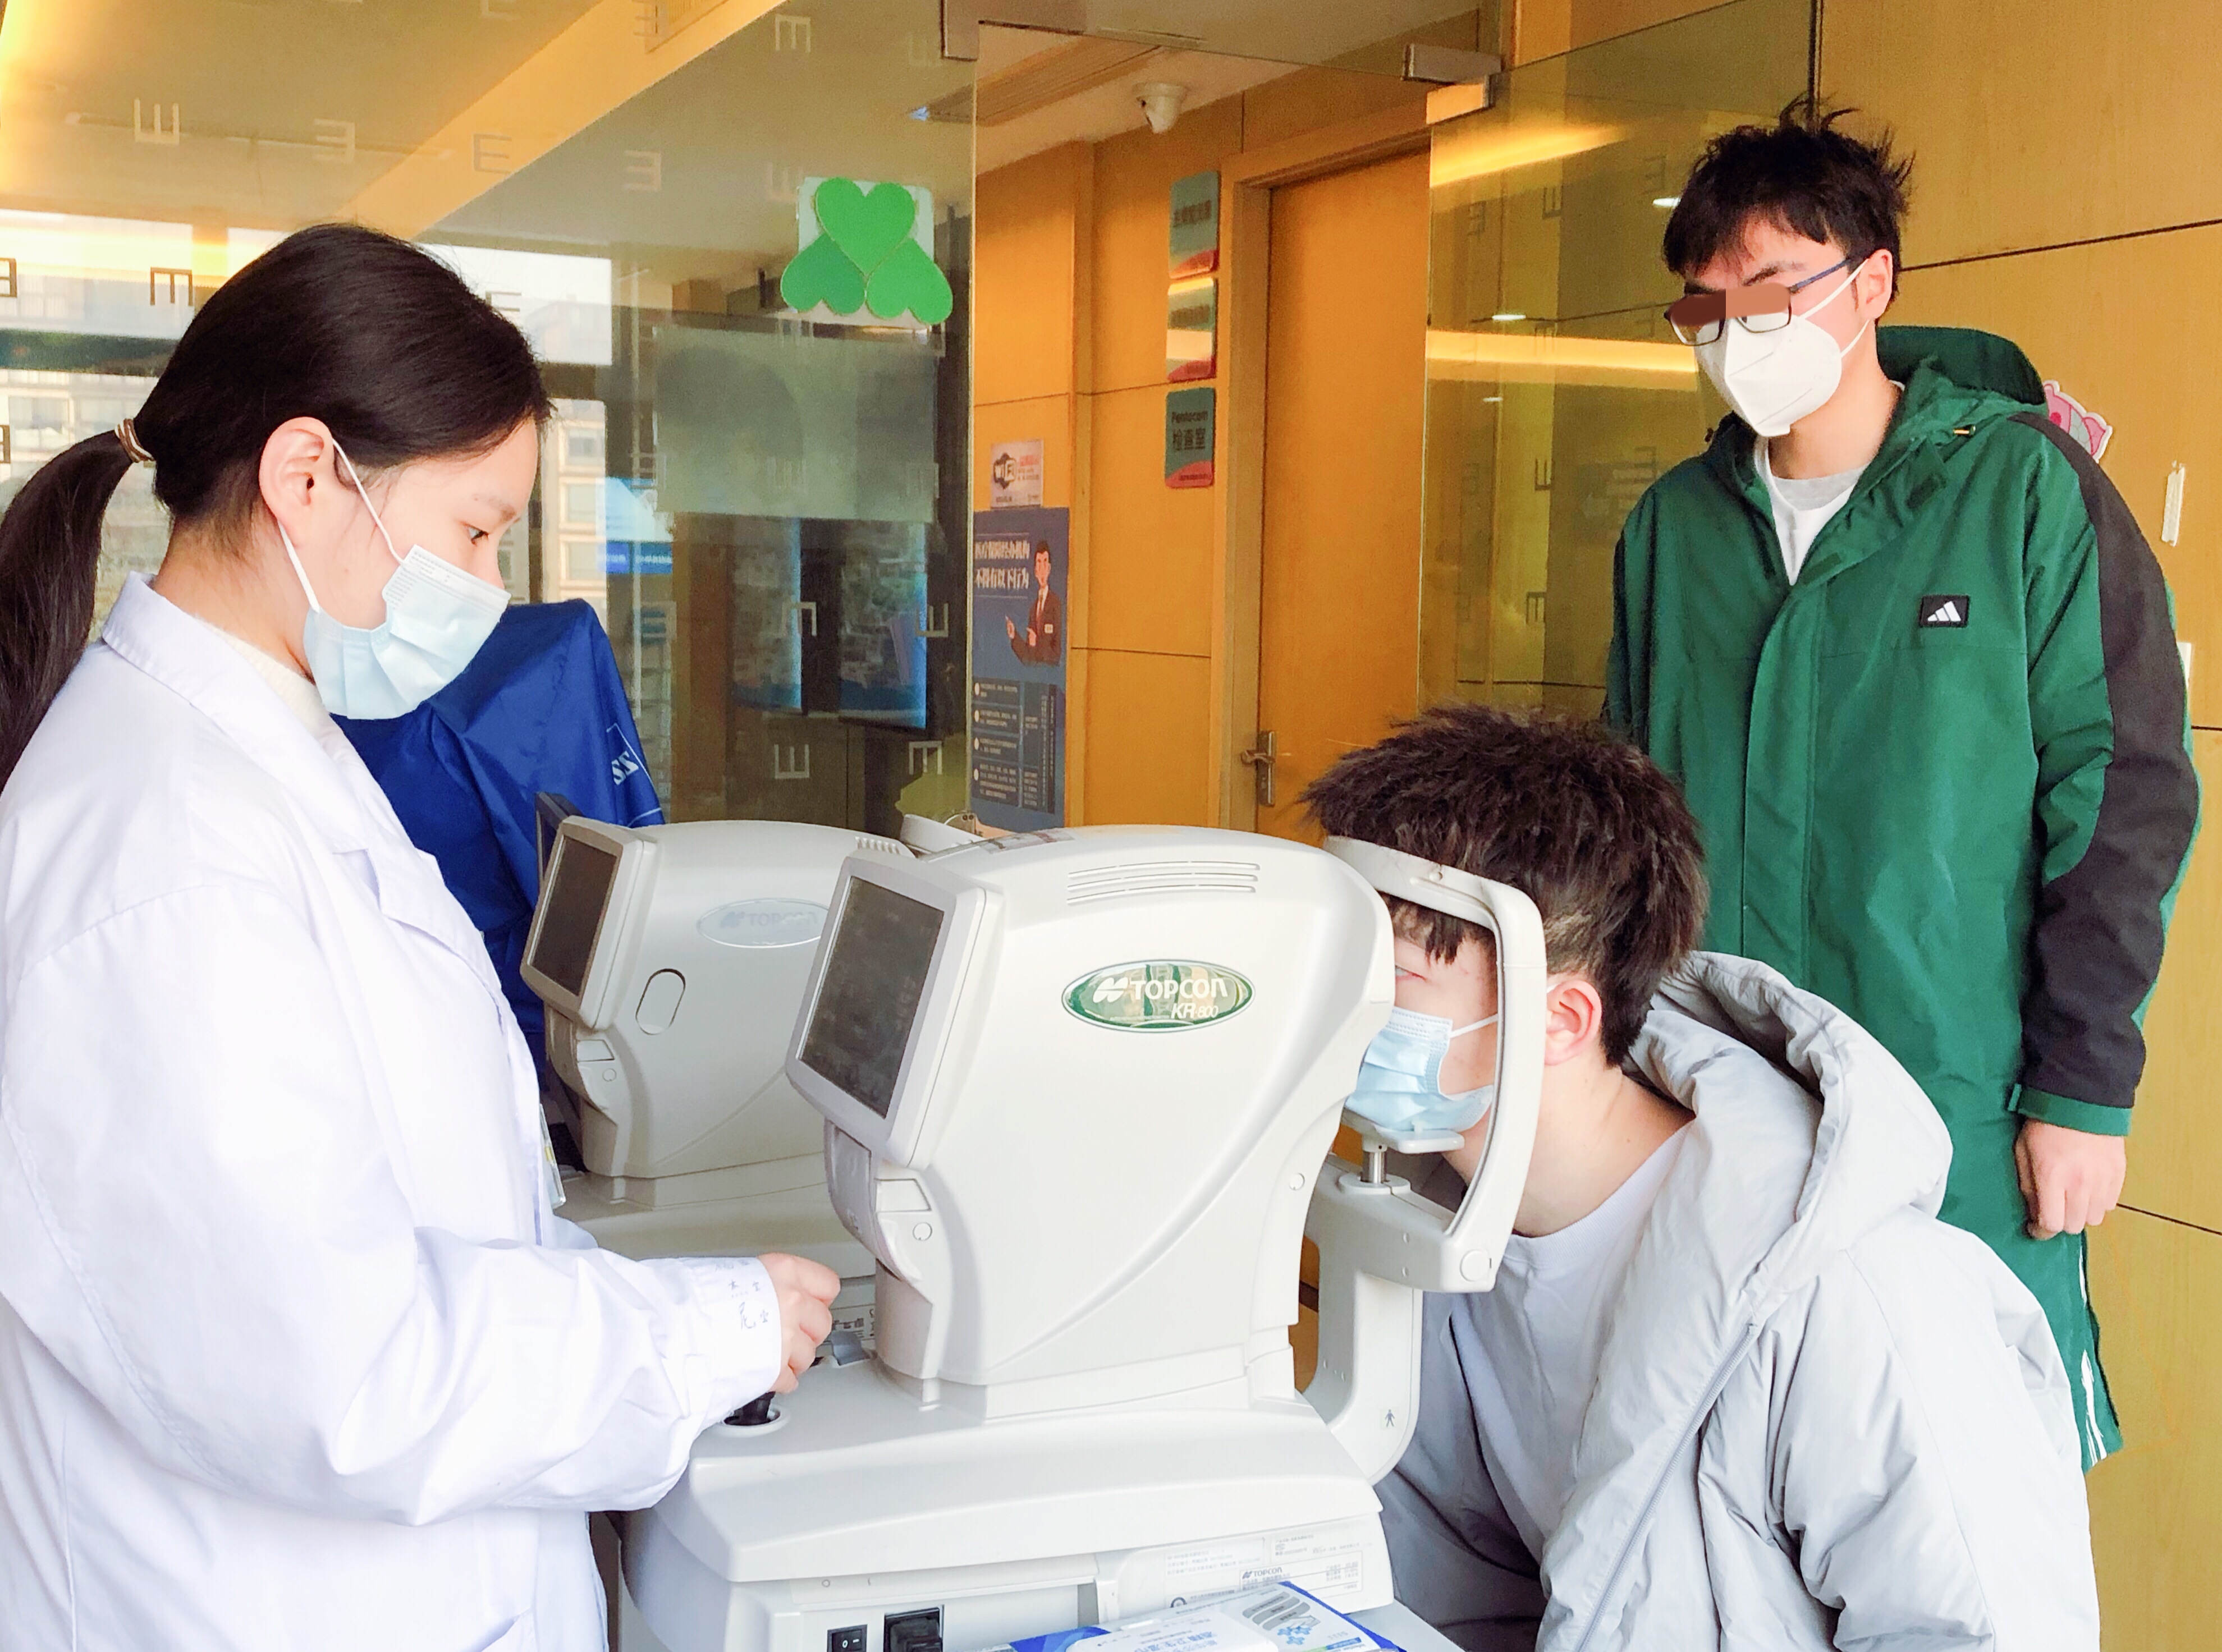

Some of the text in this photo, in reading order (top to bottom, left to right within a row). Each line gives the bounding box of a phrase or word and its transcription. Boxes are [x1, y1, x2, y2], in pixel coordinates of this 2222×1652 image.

[1172, 428, 1206, 451] 检查室
[1129, 978, 1228, 1000] TOPCON
[1171, 1002, 1219, 1019] KR-800
[1254, 1567, 1282, 1577] TOPCON
